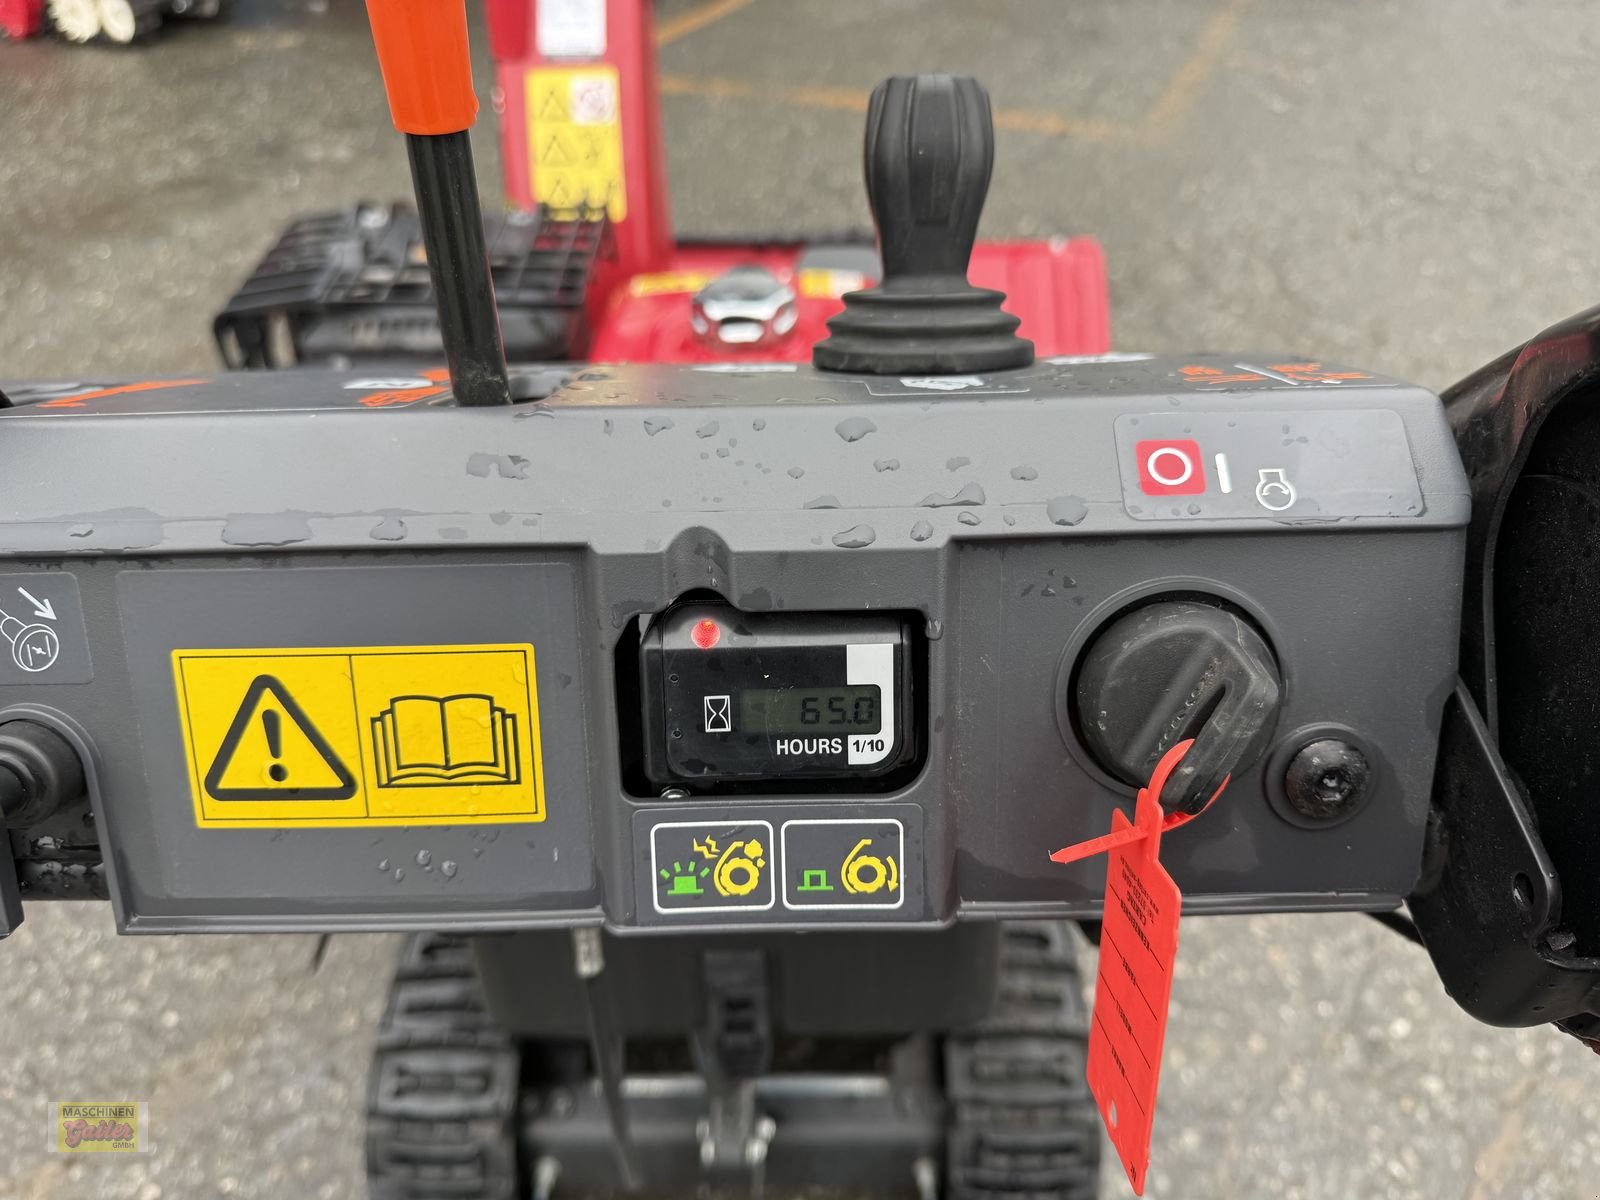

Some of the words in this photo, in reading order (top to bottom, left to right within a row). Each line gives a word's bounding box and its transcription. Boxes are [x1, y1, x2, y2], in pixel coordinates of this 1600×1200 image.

[801, 697, 874, 725] 65.0
[776, 738, 843, 755] HOURS
[852, 739, 885, 753] 1/10
